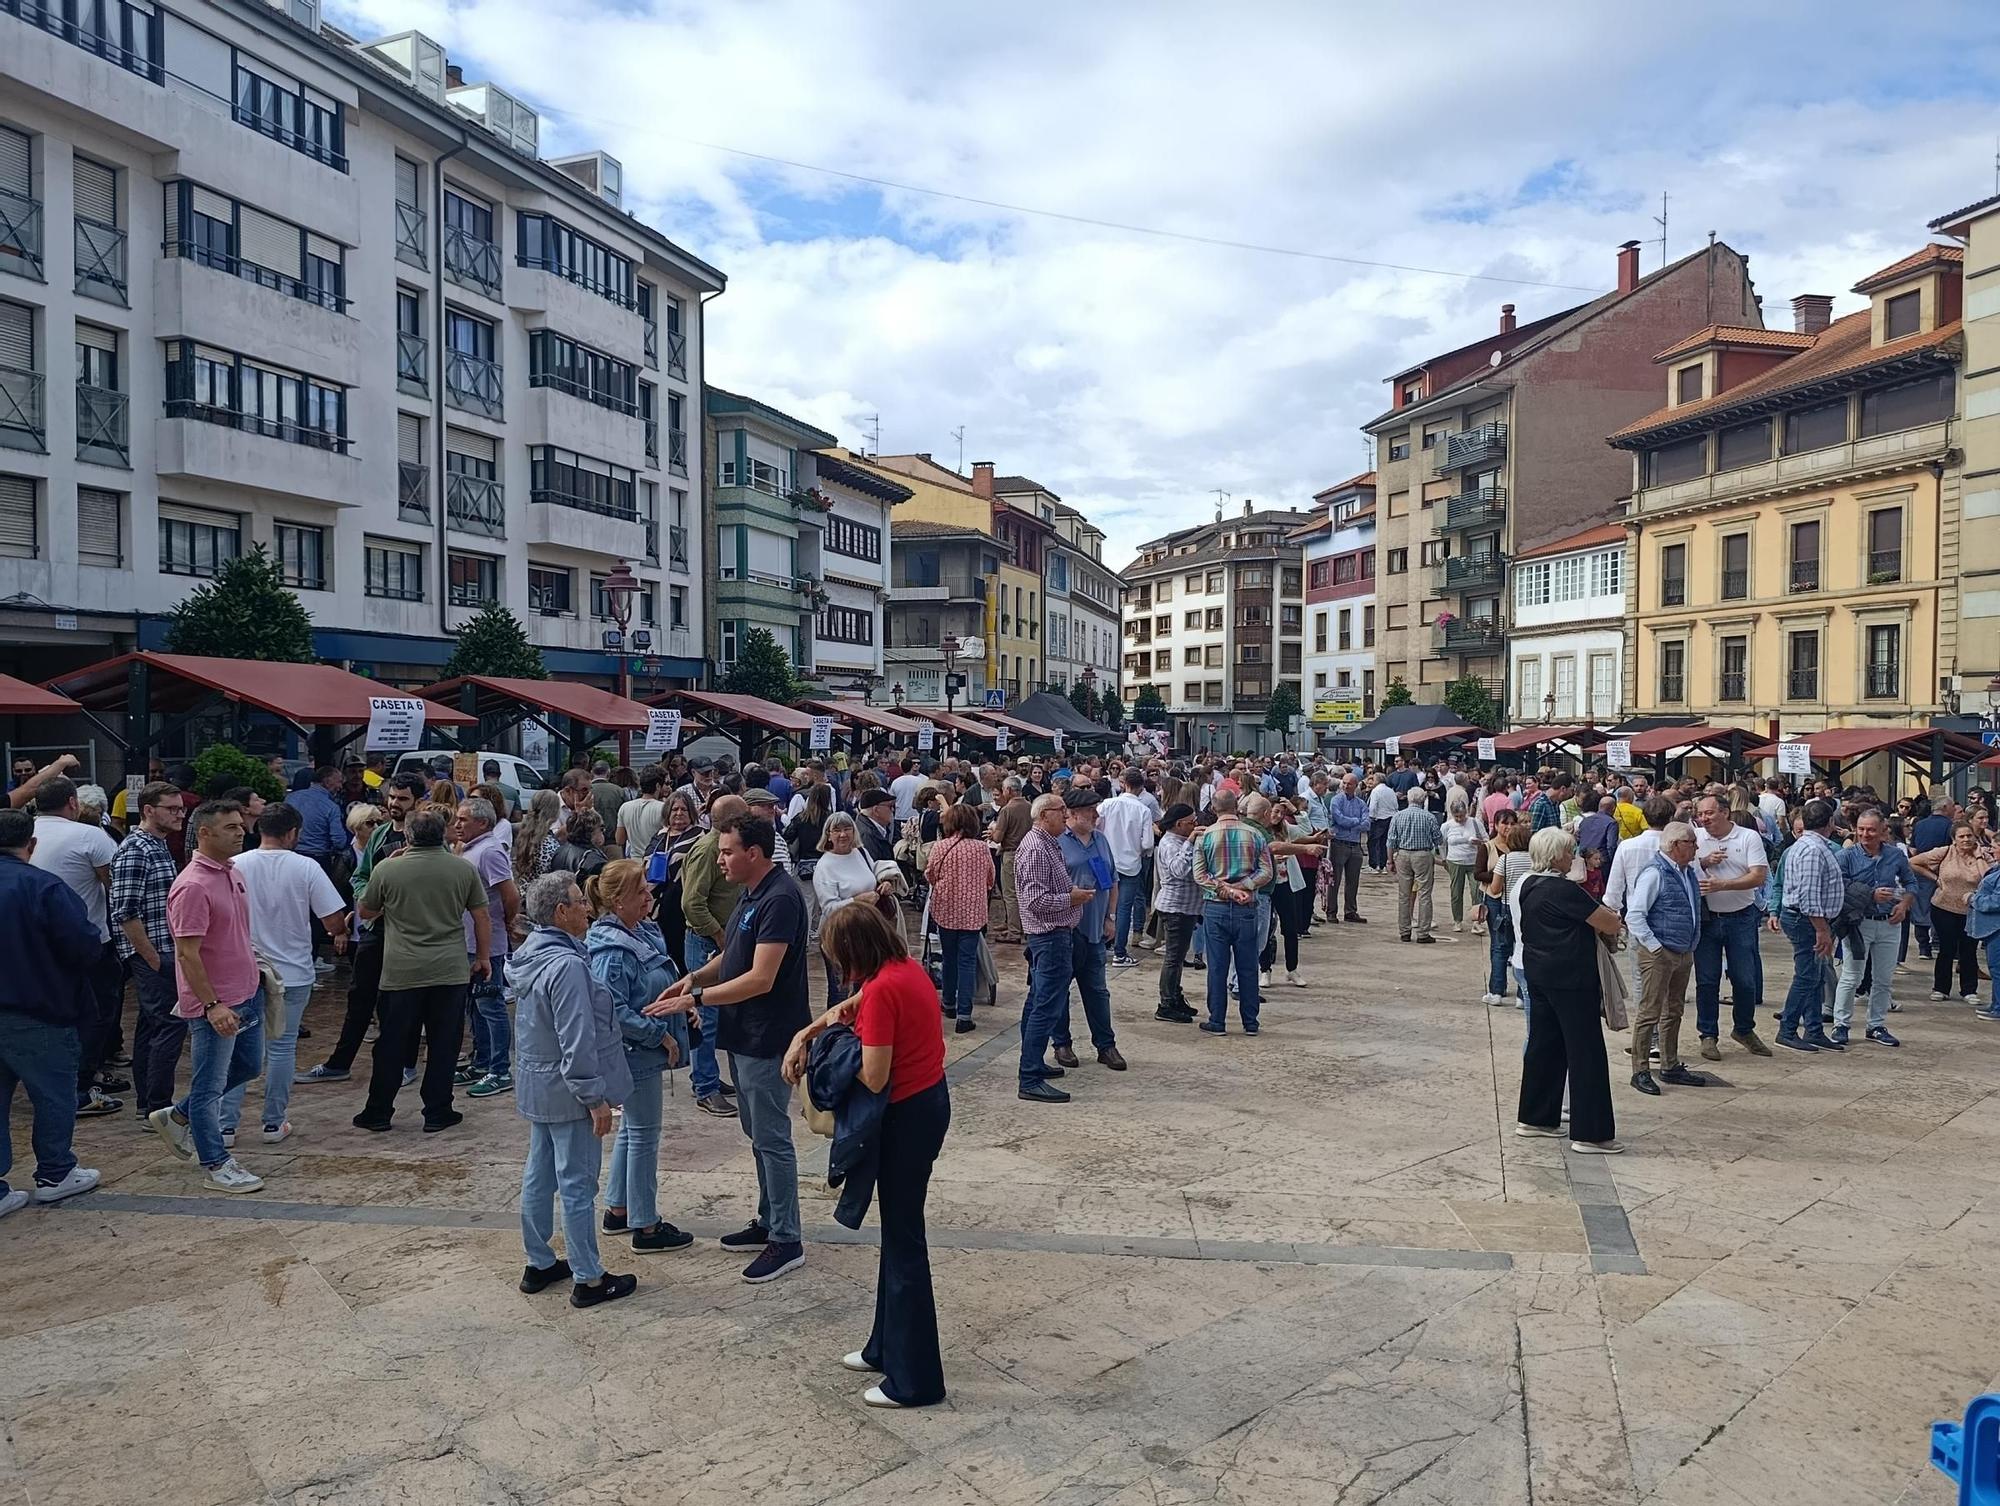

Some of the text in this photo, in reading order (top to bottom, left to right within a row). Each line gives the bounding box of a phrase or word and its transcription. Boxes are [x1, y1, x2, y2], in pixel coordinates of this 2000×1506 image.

[372, 699, 423, 711] CASETA 6
[649, 710, 674, 719] CASETA
